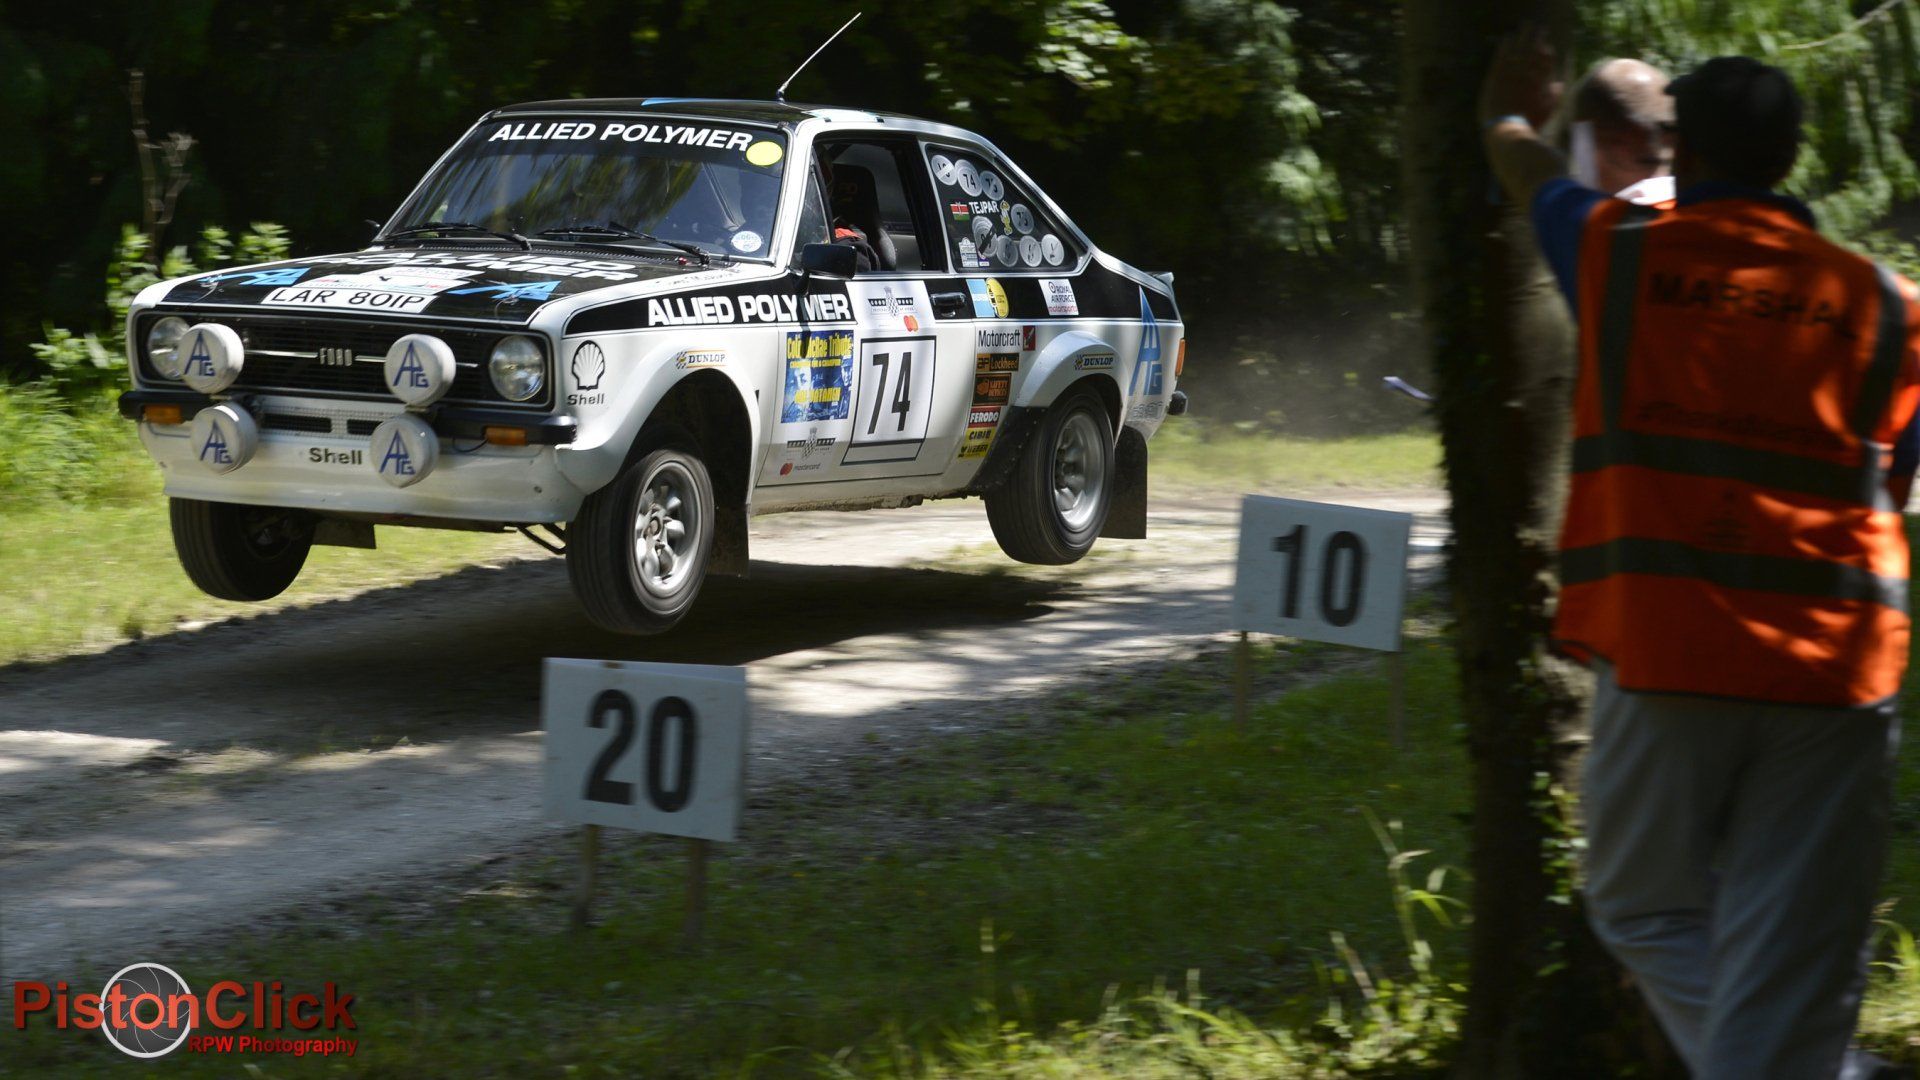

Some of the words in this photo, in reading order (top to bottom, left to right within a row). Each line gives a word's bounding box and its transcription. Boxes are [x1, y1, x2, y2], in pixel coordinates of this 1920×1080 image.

[488, 122, 597, 142] ALLIED
[600, 123, 753, 152] POLYMER
[962, 173, 977, 189] 74
[968, 201, 1000, 215] TEJPAR
[270, 289, 337, 304] LAR
[648, 296, 735, 326] ALLIED
[737, 293, 852, 322] POLYMER
[978, 328, 1021, 348] Motorcraft
[688, 353, 726, 364] DUNLOP
[990, 356, 1018, 369] Lockheed
[1083, 356, 1114, 366] DUNLOP
[567, 393, 605, 406] Shell
[867, 351, 912, 435] 74
[969, 411, 1000, 423] FERODO
[309, 447, 363, 466] Shell
[1273, 523, 1369, 627] 10
[584, 688, 700, 813] 20
